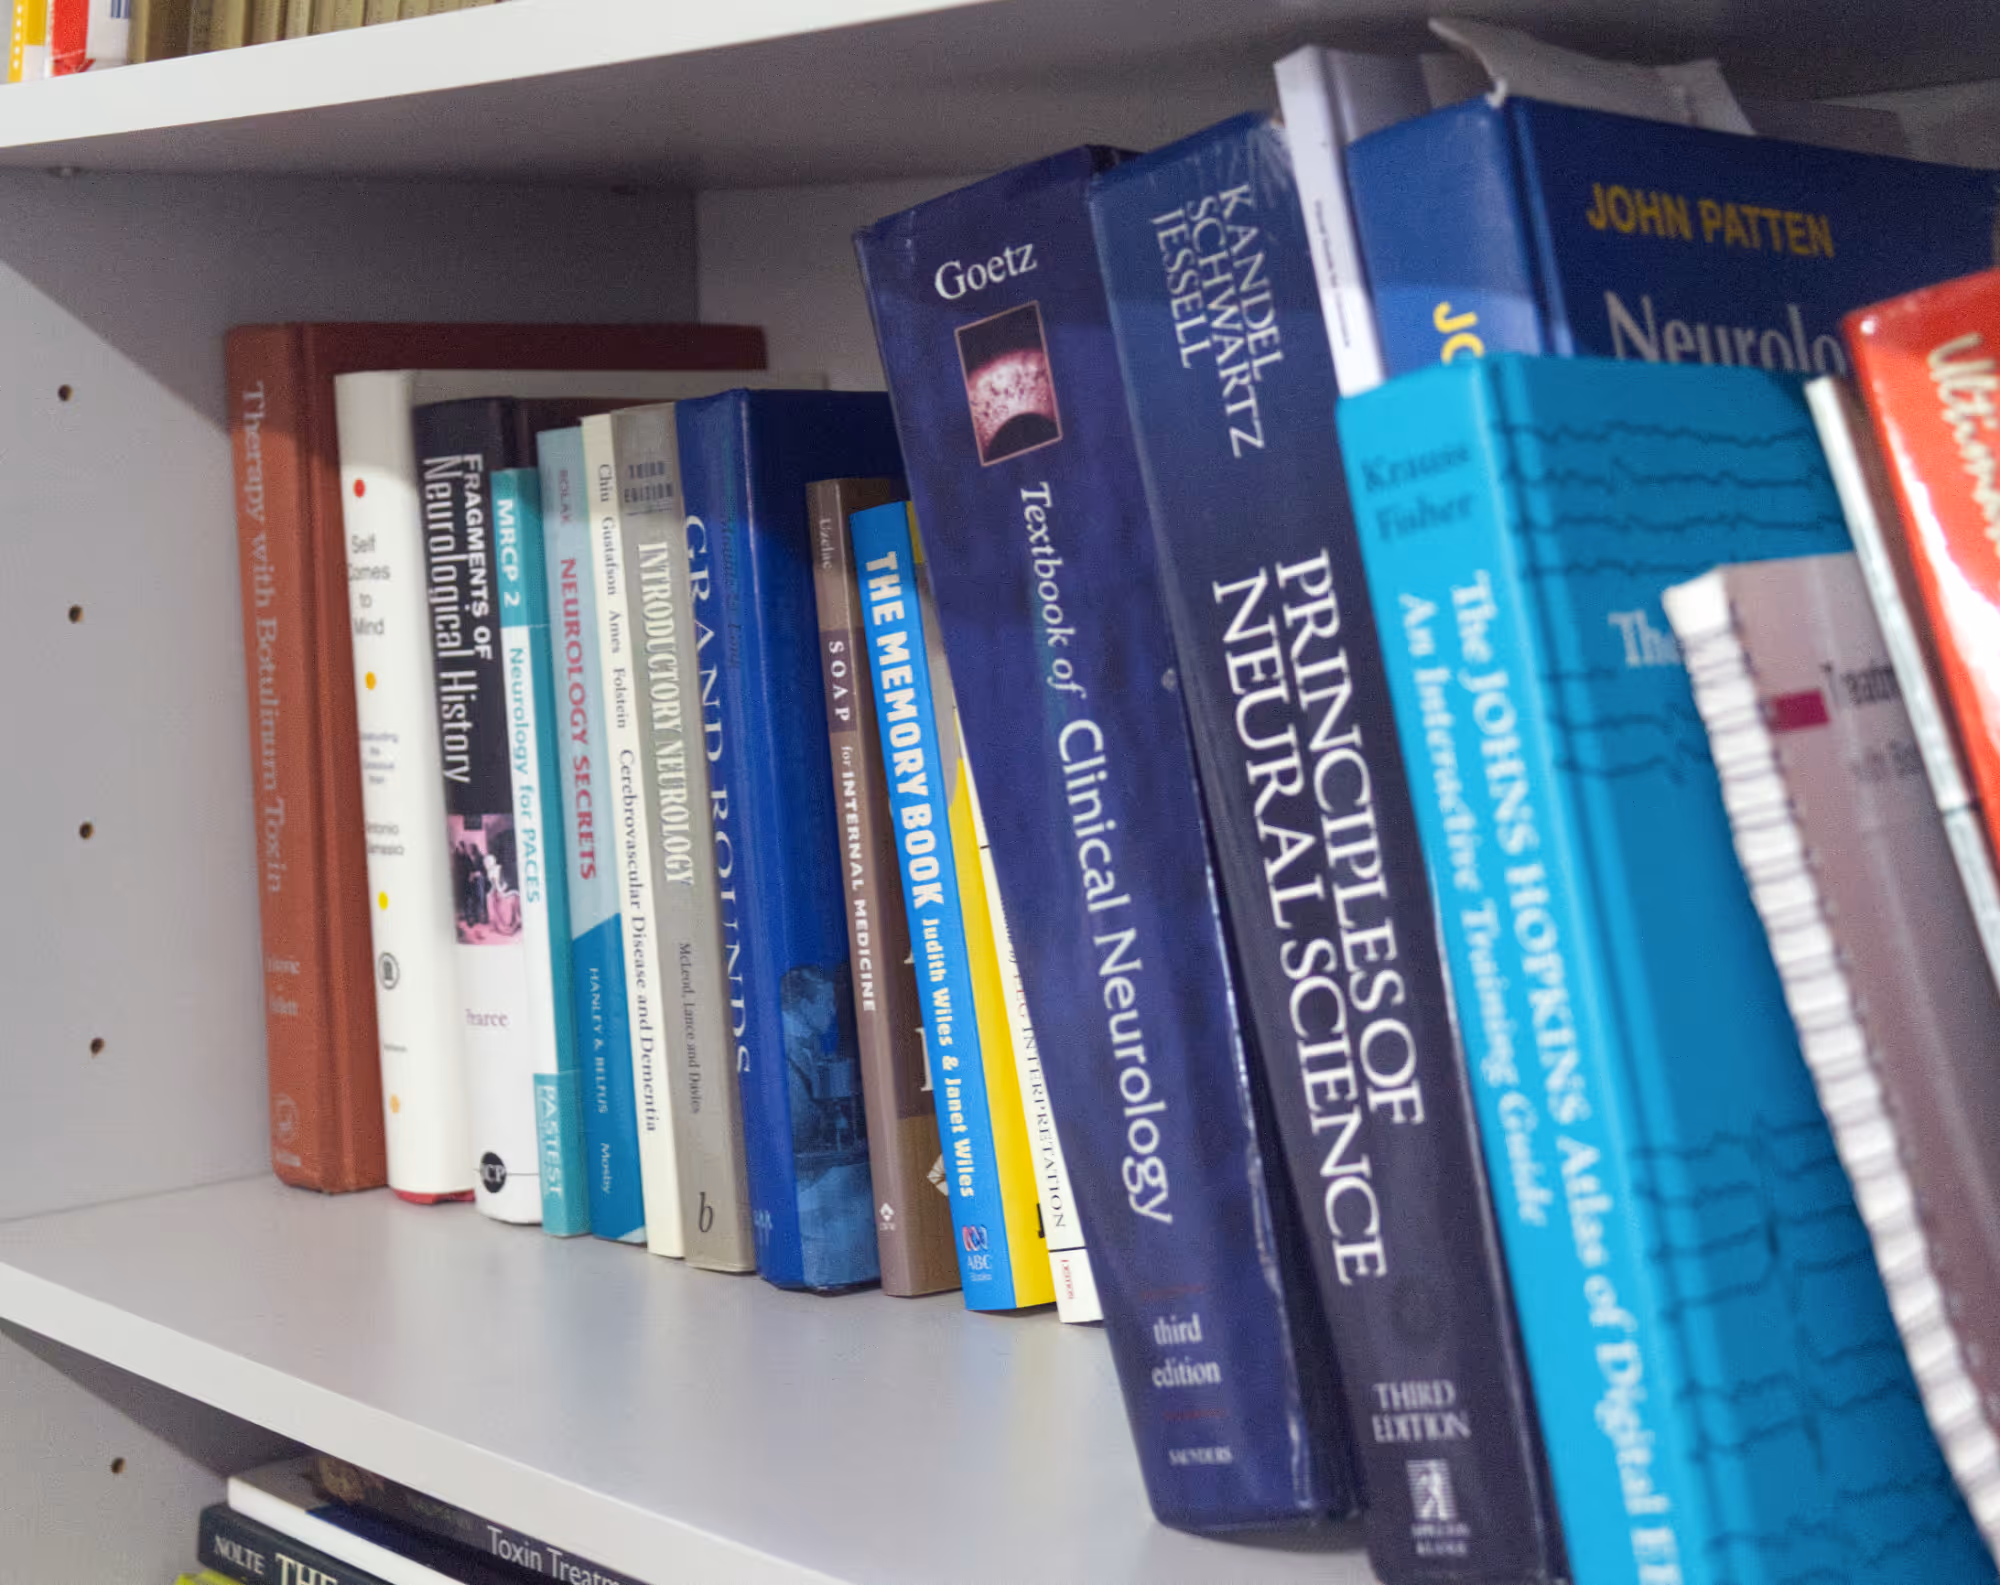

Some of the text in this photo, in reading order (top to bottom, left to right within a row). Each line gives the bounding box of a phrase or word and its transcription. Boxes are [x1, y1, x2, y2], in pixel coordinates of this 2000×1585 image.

[1587, 183, 1835, 258] JOHN PATTEN
[934, 243, 1038, 300] Goetz
[1151, 207, 1211, 369] JESSELL
[1219, 184, 1285, 382] KANDEL
[1187, 195, 1265, 459] SCHWARTZ
[242, 380, 265, 523] Therapy
[253, 532, 275, 607] with
[462, 454, 493, 659] FRAGMENTS OF
[497, 499, 521, 608] MRCP 2
[602, 516, 619, 596] Gustafson
[423, 456, 478, 785] Neurological History
[609, 610, 622, 654] Ames
[685, 516, 724, 763] GRAND
[1450, 571, 1498, 664] The
[560, 558, 597, 880] NEUROLOGY SECRETS
[613, 668, 626, 729] Folstein
[638, 542, 693, 886] INTRODUCTORY NEUROLOGY
[509, 647, 542, 904] Neurology for PACES
[1457, 669, 1540, 856] JOHNS
[265, 797, 288, 893] Toxin
[620, 749, 643, 909] Cerebrovascular
[828, 641, 877, 1012] SOAP for INTERNAL MEDICINE
[865, 551, 976, 1198] THE MEMORY BOOK Judith Wiles & Janet Wiles
[1020, 482, 1174, 1225] Textbook of Clinical Neurology
[1276, 549, 1425, 1126] PRINCIPLES OF
[631, 917, 647, 990] Disease
[1213, 568, 1388, 1286] NEURAL SCIENCE
[1399, 593, 1555, 1226] An Interactive Training Guide
[589, 968, 603, 1031] HANLEY
[638, 994, 653, 1031] and
[683, 992, 699, 1031] Lance
[1505, 862, 1592, 1123] HOPKINS
[641, 1036, 660, 1132] Dementia
[686, 1036, 700, 1060] and
[688, 1066, 702, 1115] Davies
[543, 1085, 563, 1199] PASTEST
[601, 1142, 612, 1197] Mosby
[1021, 1026, 1067, 1228] INTERPRETATION
[698, 1192, 714, 1233] b
[1556, 1137, 1614, 1268] Atlas
[967, 1254, 992, 1271] ABC
[1583, 1275, 1638, 1331] of
[1151, 1356, 1221, 1389] edition
[1153, 1313, 1202, 1346] third
[1373, 1410, 1471, 1443] EDITION
[1374, 1379, 1456, 1410] THIRD
[1594, 1341, 1670, 1514] Digital
[214, 1534, 339, 1585] NOLTE THE
[487, 1525, 542, 1573] Toxin
